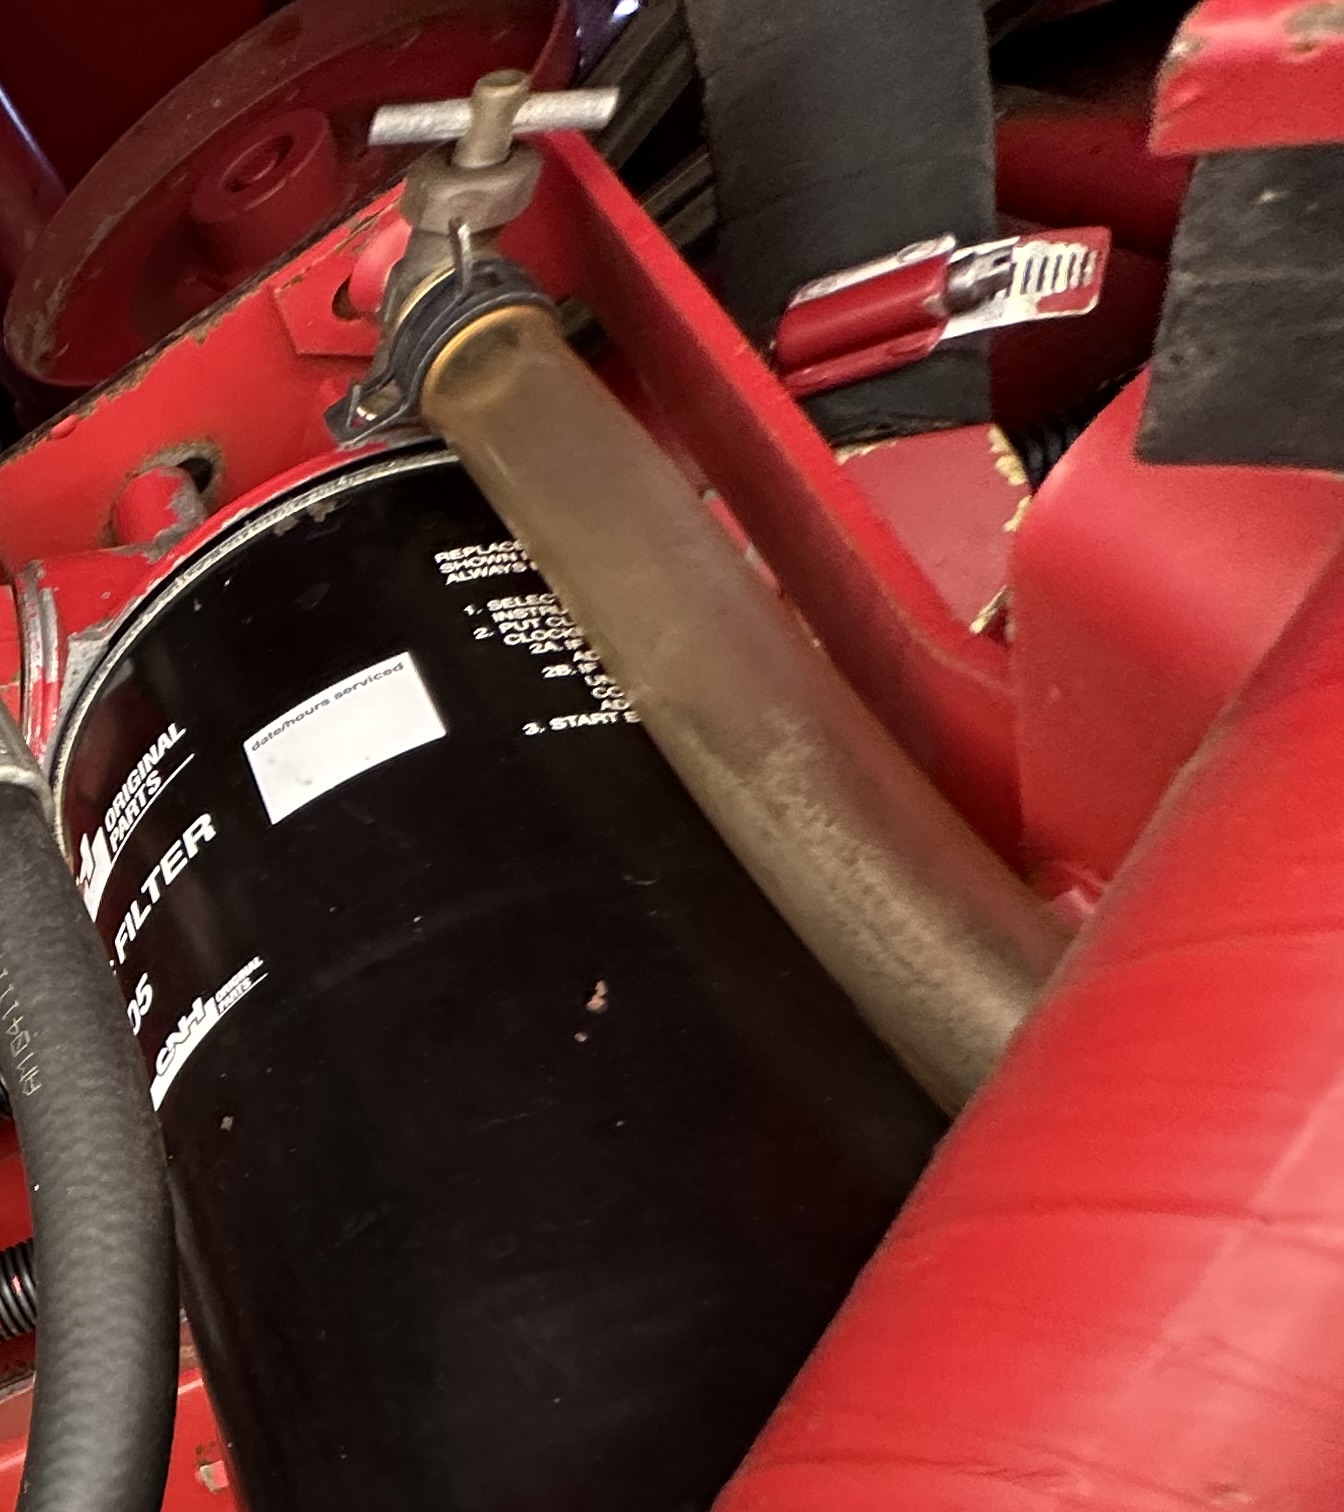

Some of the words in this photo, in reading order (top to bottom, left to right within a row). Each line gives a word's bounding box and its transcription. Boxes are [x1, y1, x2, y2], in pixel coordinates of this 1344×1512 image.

[445, 561, 527, 586] ALWAYS
[486, 593, 559, 612] SELEC
[498, 617, 541, 634] PUT
[503, 627, 584, 646] CLOCK
[251, 698, 331, 752] date/hours
[334, 661, 405, 700] serviced
[549, 711, 618, 731] START
[104, 722, 187, 832] ORIGINAL
[109, 768, 163, 853] PARTS
[114, 812, 217, 964] FILTER
